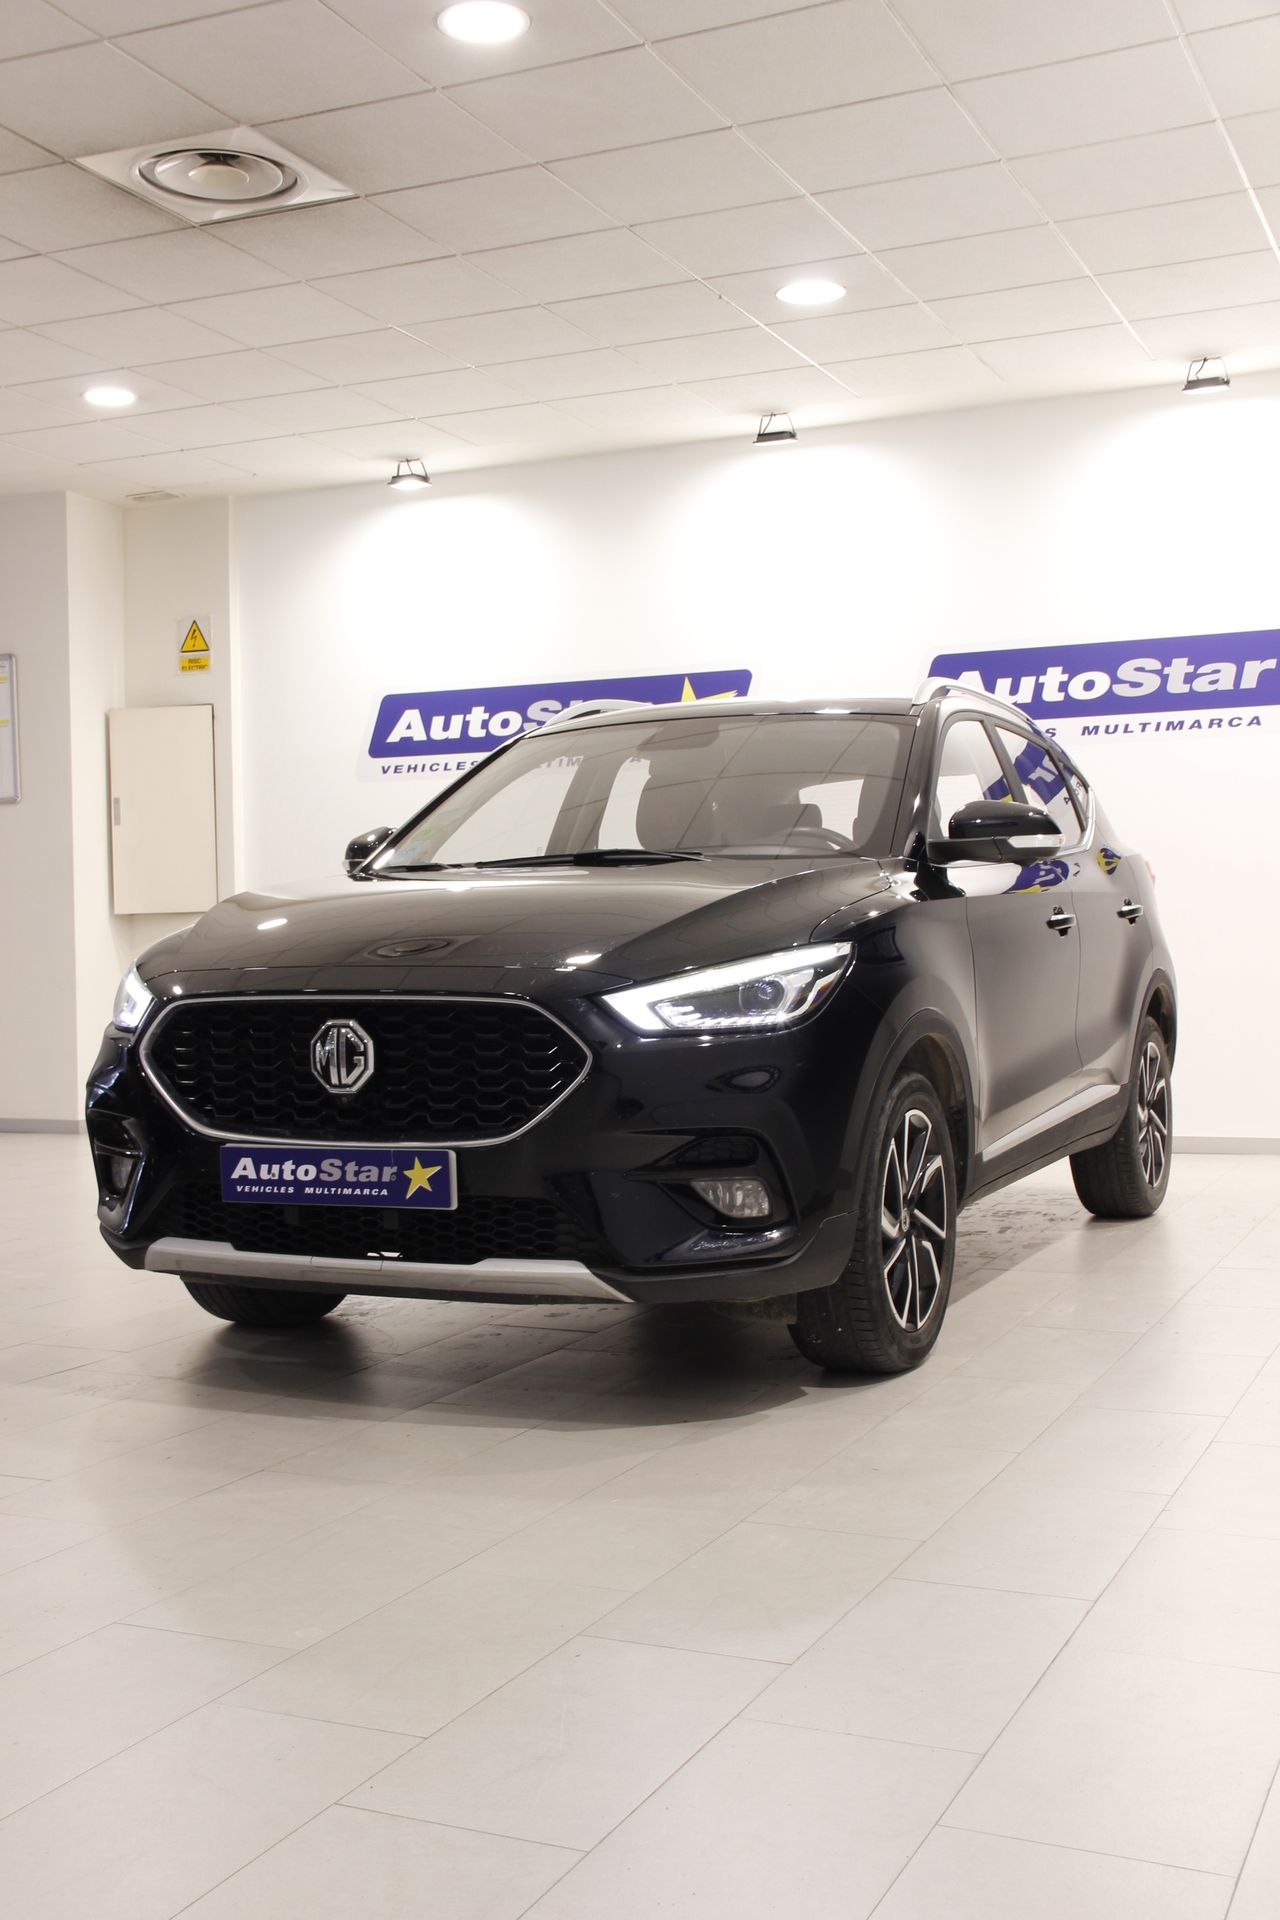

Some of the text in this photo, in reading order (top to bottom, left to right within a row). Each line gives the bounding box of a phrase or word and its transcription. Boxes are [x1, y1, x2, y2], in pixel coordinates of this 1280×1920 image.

[386, 698, 584, 743] AutoS
[1081, 715, 1262, 736] MULTIMARCA
[315, 1027, 365, 1086] MG
[231, 1157, 398, 1182] AutoStar
[236, 1185, 388, 1196] VEHICLES MULTIMARCA
